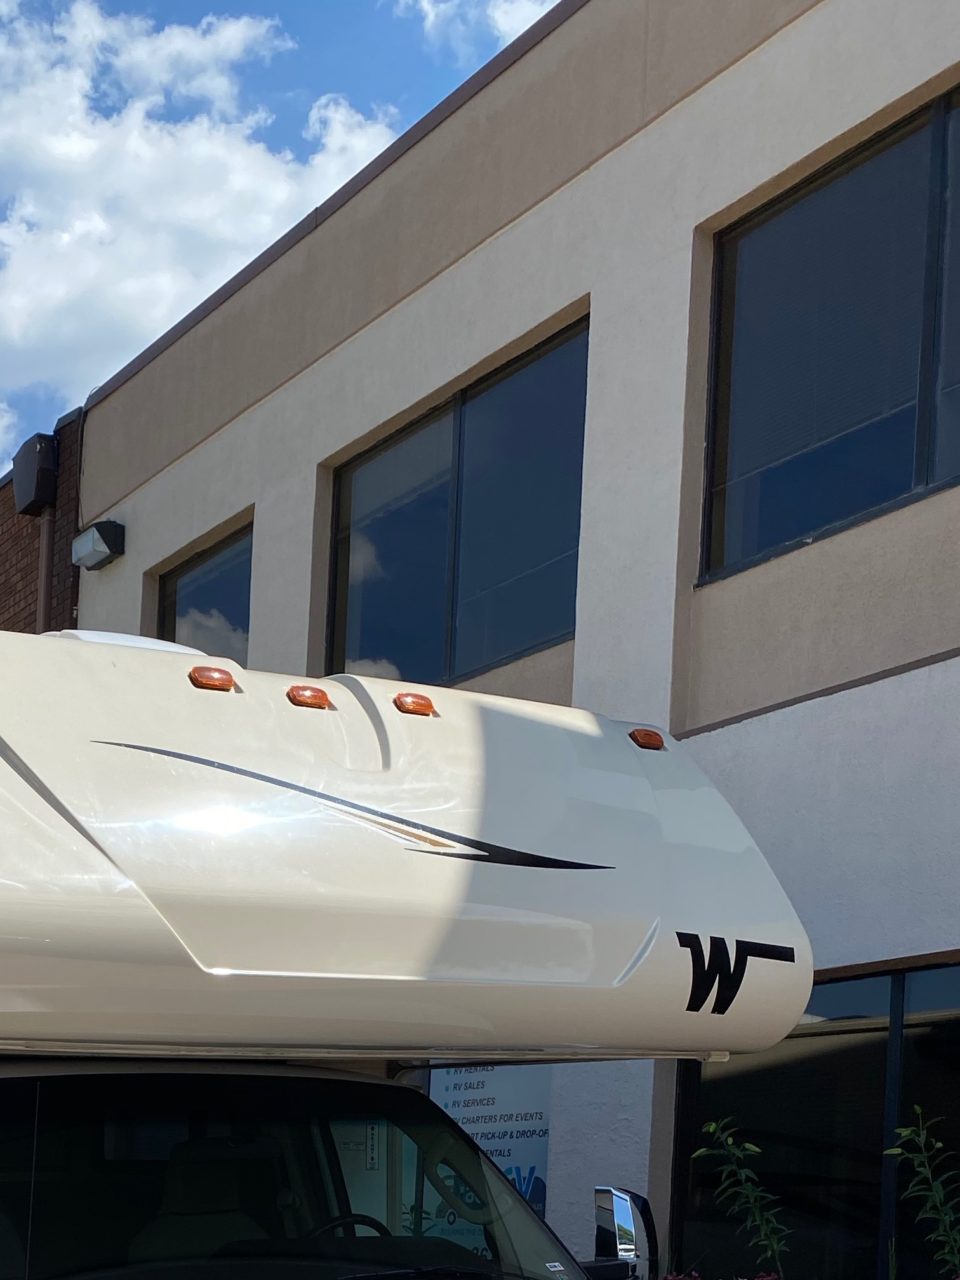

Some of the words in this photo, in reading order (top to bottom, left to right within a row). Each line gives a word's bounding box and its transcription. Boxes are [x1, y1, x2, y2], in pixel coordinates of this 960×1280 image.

[675, 931, 795, 1015] W
[464, 1065, 495, 1074] RENTALS
[452, 1084, 462, 1092] RV
[464, 1081, 486, 1091] SALES
[451, 1100, 461, 1108] RV
[462, 1097, 496, 1108] SERVICES
[461, 1114, 498, 1125] CHARTERS
[499, 1113, 514, 1123] FOR
[515, 1112, 543, 1121] EVENTS
[480, 1131, 508, 1140] PICK-UP
[515, 1128, 549, 1139] DROP-OF
[484, 1148, 512, 1158] ENTALS
